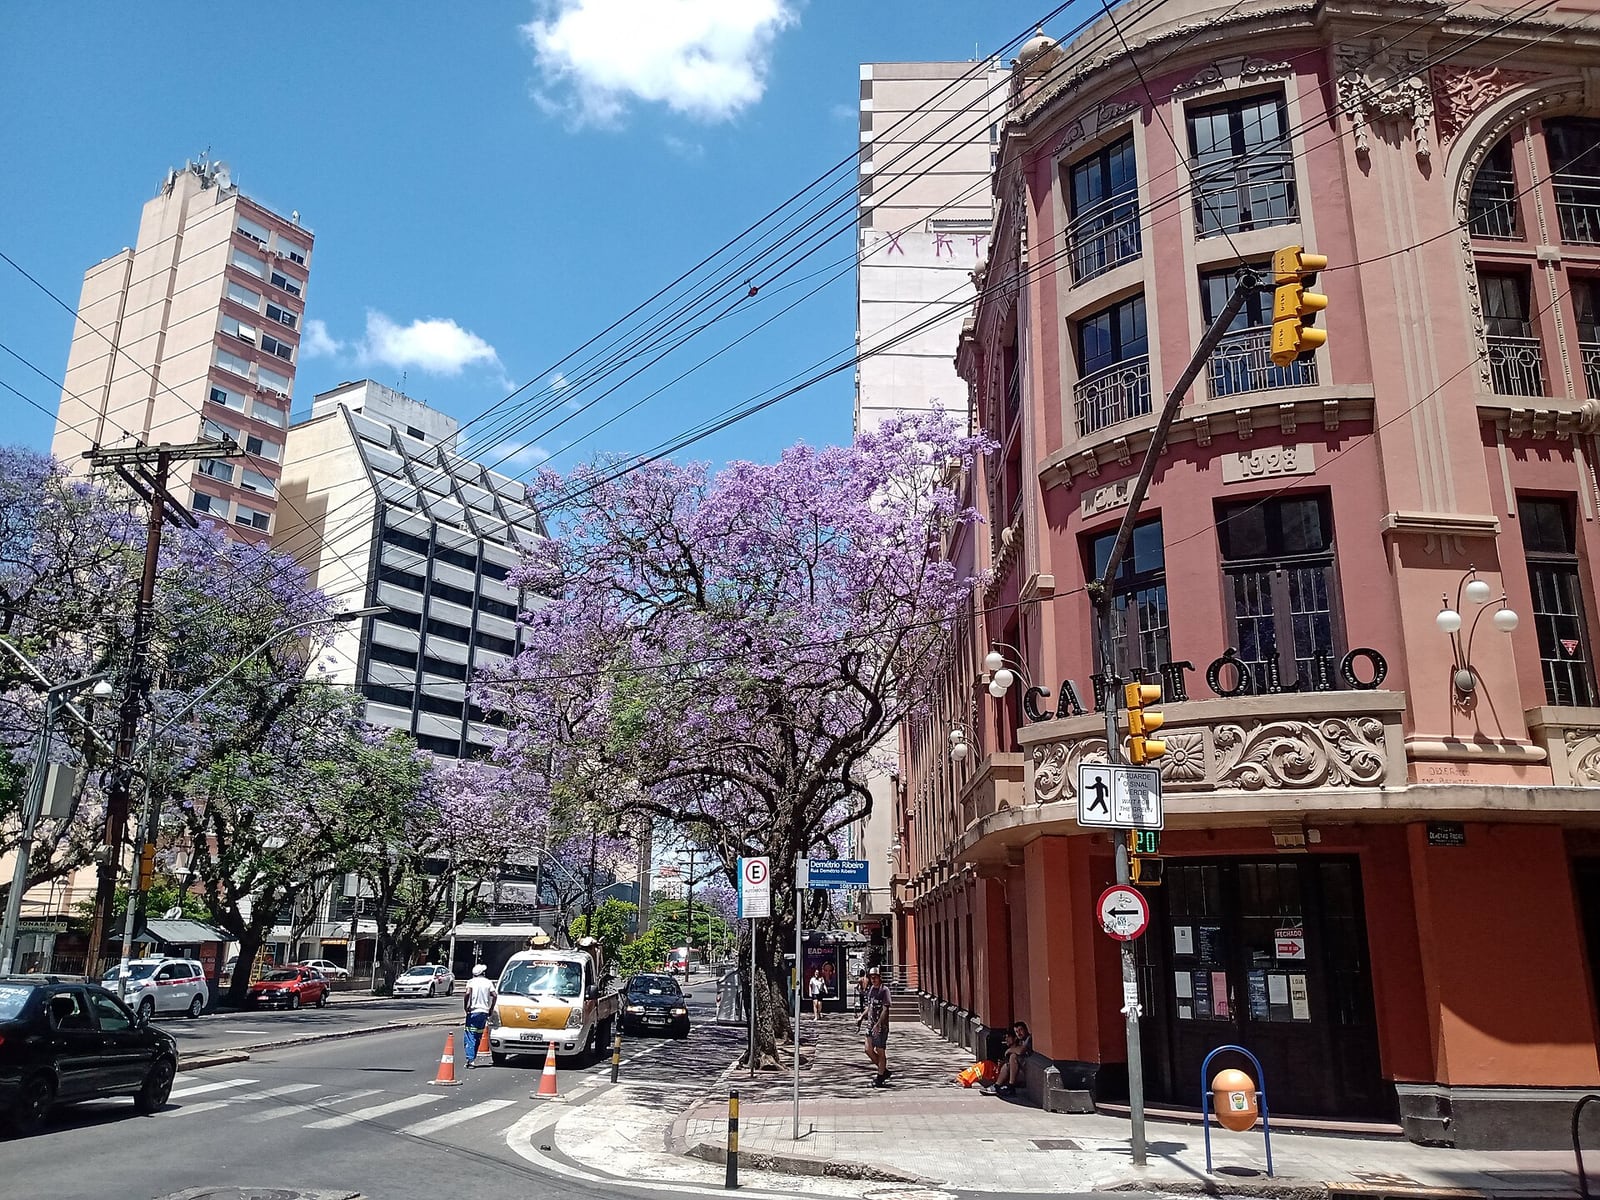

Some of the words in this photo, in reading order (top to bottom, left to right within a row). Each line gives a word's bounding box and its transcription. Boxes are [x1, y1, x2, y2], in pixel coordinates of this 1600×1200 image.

[1239, 448, 1298, 476] 1928
[1120, 772, 1152, 781] AGUARDE
[1124, 788, 1147, 796] VERDE
[1136, 831, 1155, 853] 20
[810, 860, 841, 869] Demétrio
[841, 861, 865, 869] Ribeiro
[752, 865, 761, 879] E
[1276, 930, 1302, 938] FECHADO
